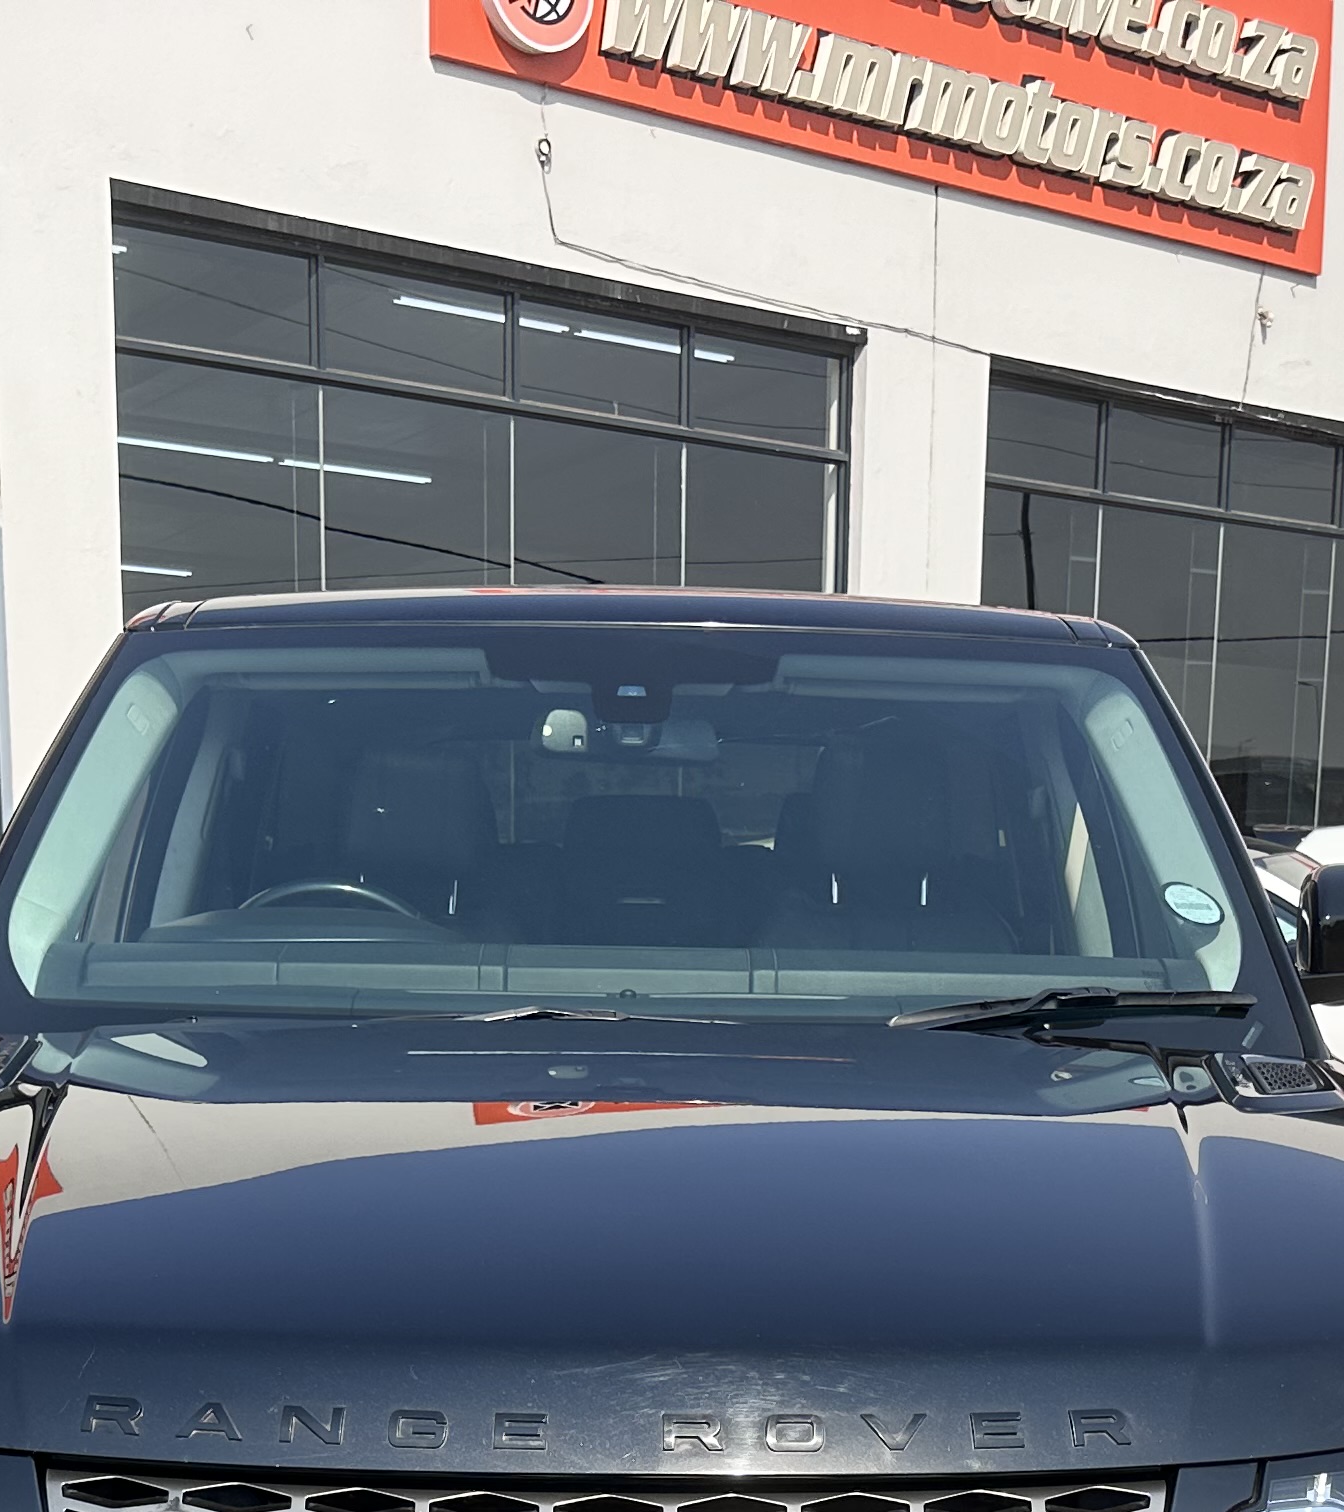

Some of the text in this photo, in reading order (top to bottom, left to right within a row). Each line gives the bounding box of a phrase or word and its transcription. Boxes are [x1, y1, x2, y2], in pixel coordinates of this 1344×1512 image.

[600, 0, 1315, 230] www.mrmotors.co.za
[80, 1394, 1132, 1453] RANGE ROVER
